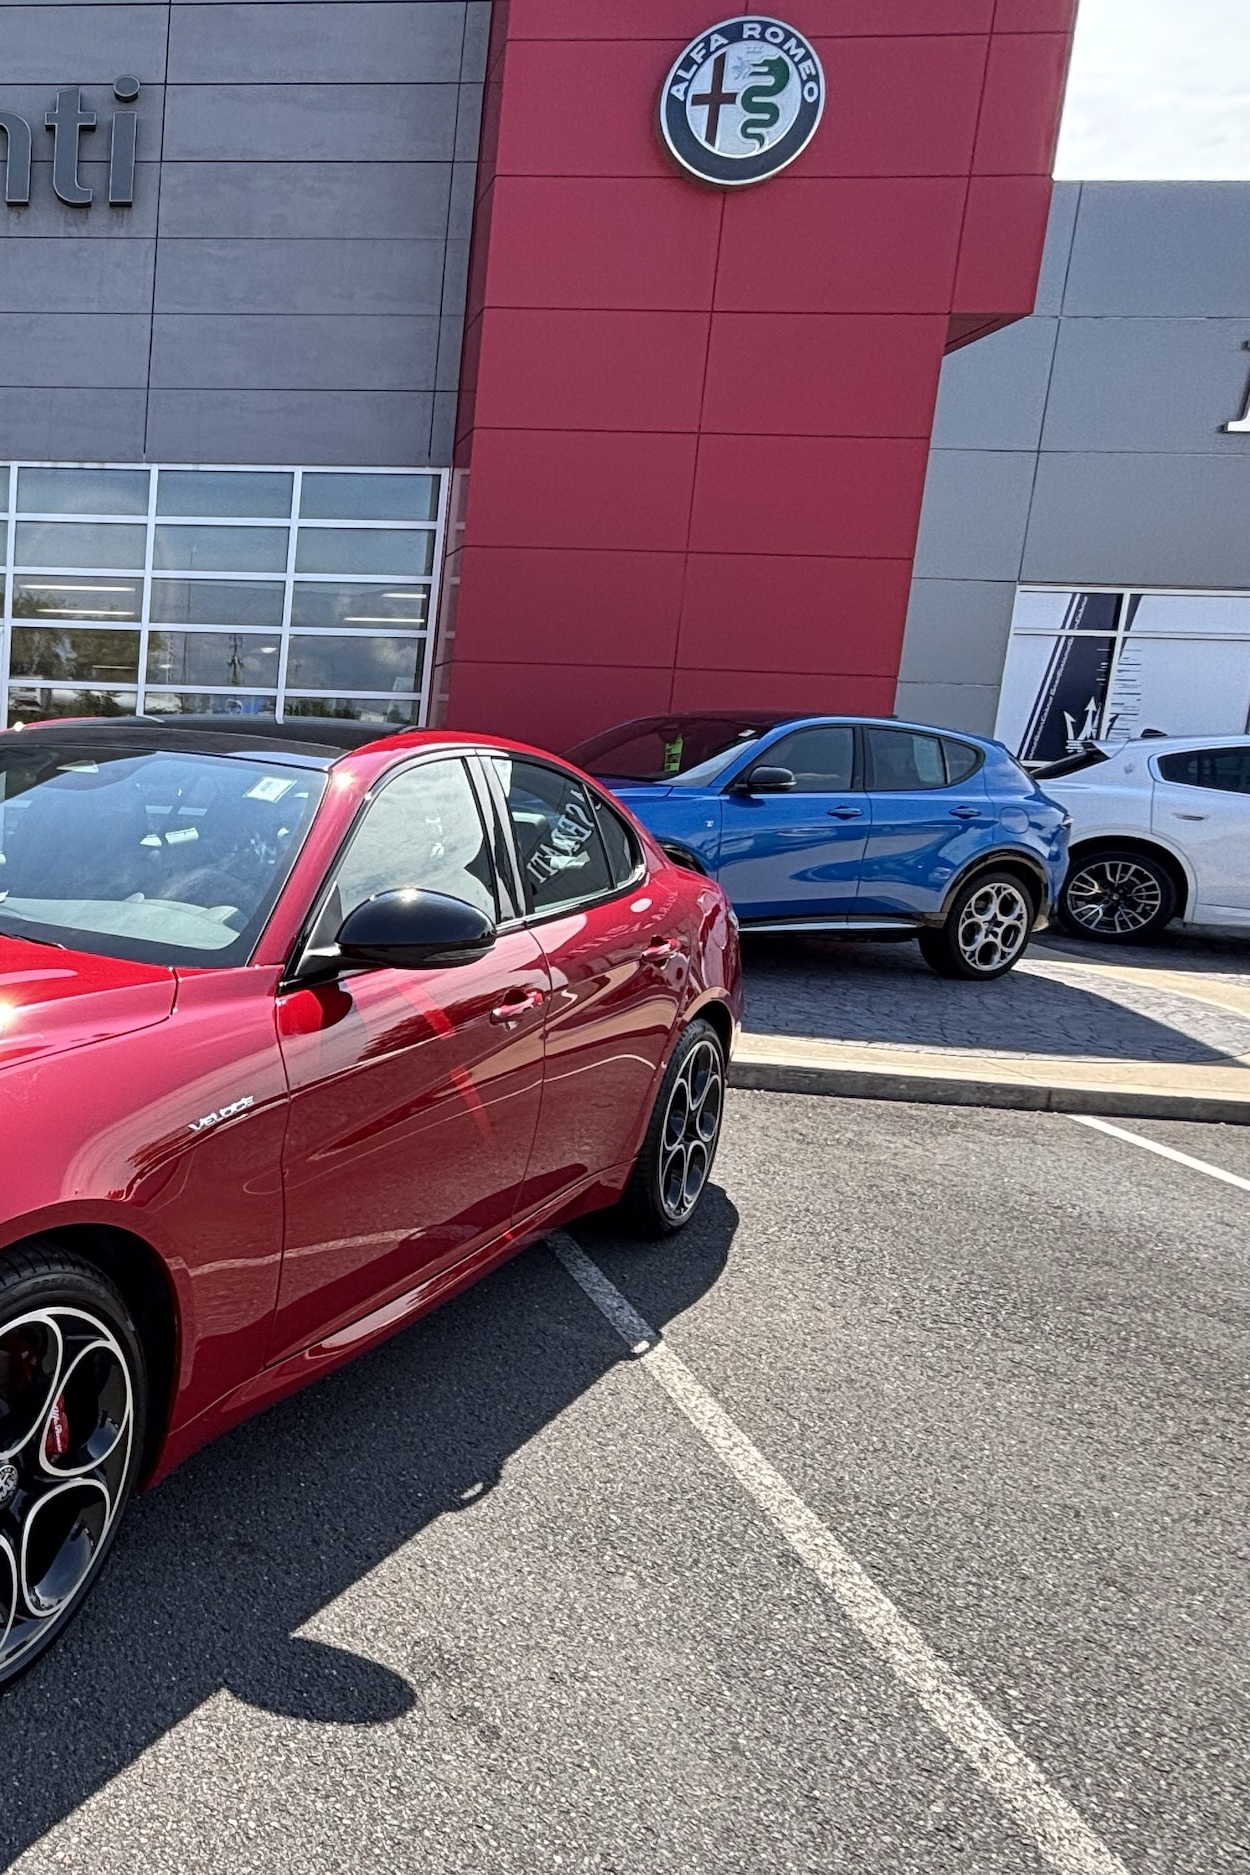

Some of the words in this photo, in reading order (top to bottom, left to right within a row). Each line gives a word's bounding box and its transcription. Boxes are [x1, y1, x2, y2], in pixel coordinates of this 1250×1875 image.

[669, 33, 729, 102] ALFA
[742, 23, 819, 103] ROMEO
[188, 1096, 254, 1132] VELOCE
